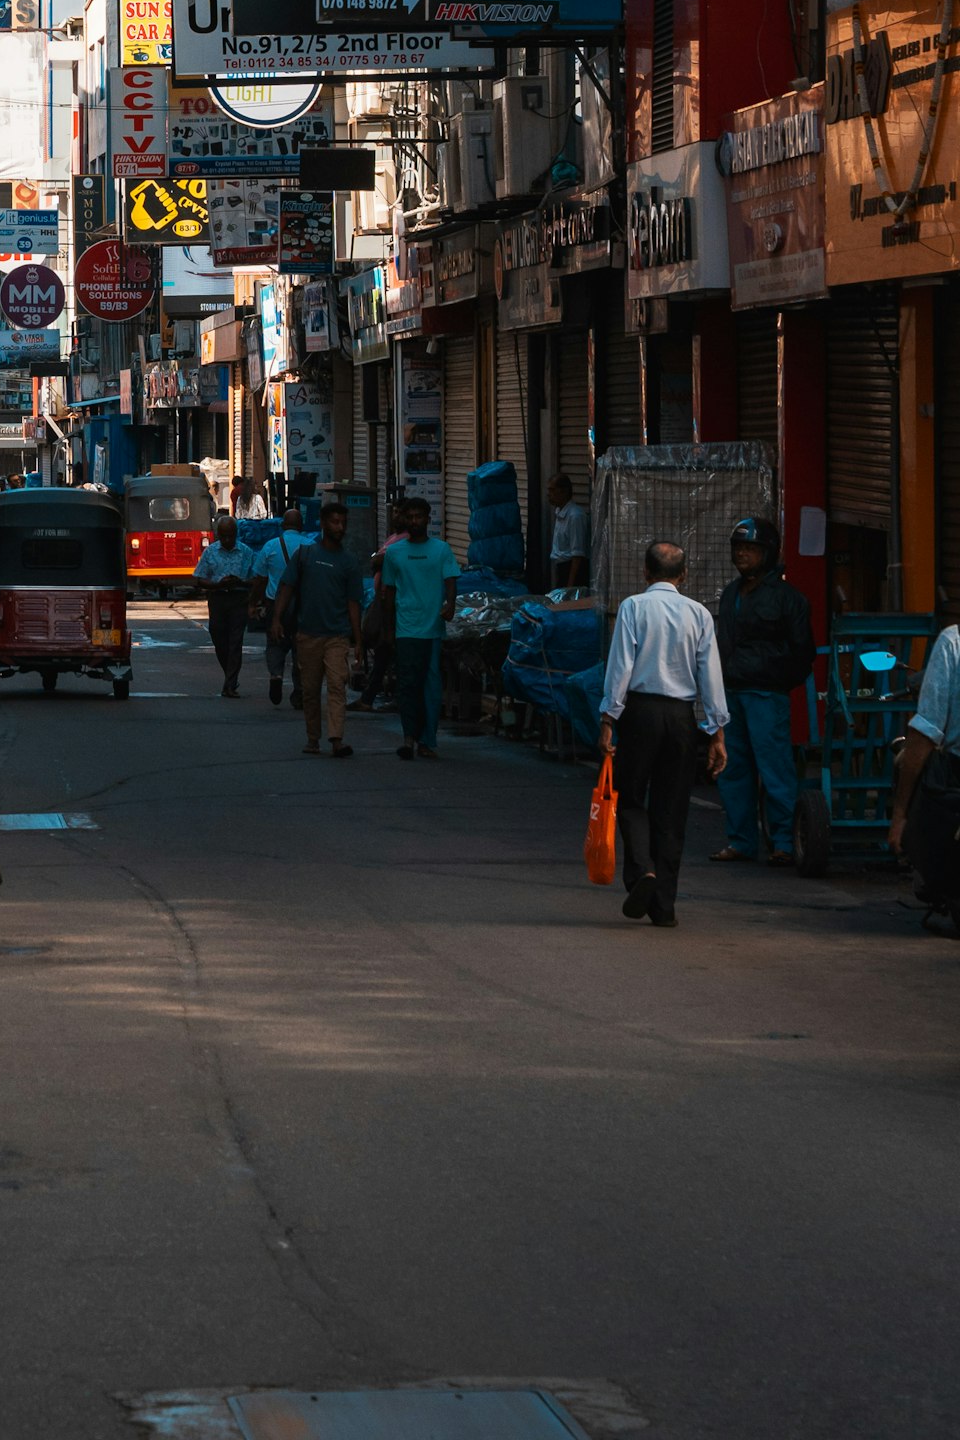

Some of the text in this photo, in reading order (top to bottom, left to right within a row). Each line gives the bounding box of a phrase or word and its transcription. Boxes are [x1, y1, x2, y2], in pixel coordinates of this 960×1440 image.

[125, 2, 160, 18] SUN
[434, 3, 553, 23] HIKVISION
[126, 24, 161, 40] CAR
[221, 33, 443, 58] No.91,2/5 2nd Floor
[123, 70, 156, 153] CCTV
[114, 154, 163, 164] HIKVISION
[116, 163, 137, 176] 87/1
[178, 163, 197, 173] 87/17
[178, 224, 198, 234] 83/3
[18, 240, 32, 249] 39
[79, 283, 114, 291] PHONE
[8, 284, 56, 304] MM
[88, 291, 142, 300] SOLUTIONS
[8, 306, 56, 314] MOBILE
[100, 301, 129, 311] 59/B3
[200, 303, 216, 311] STORM
[22, 313, 41, 325] 39
